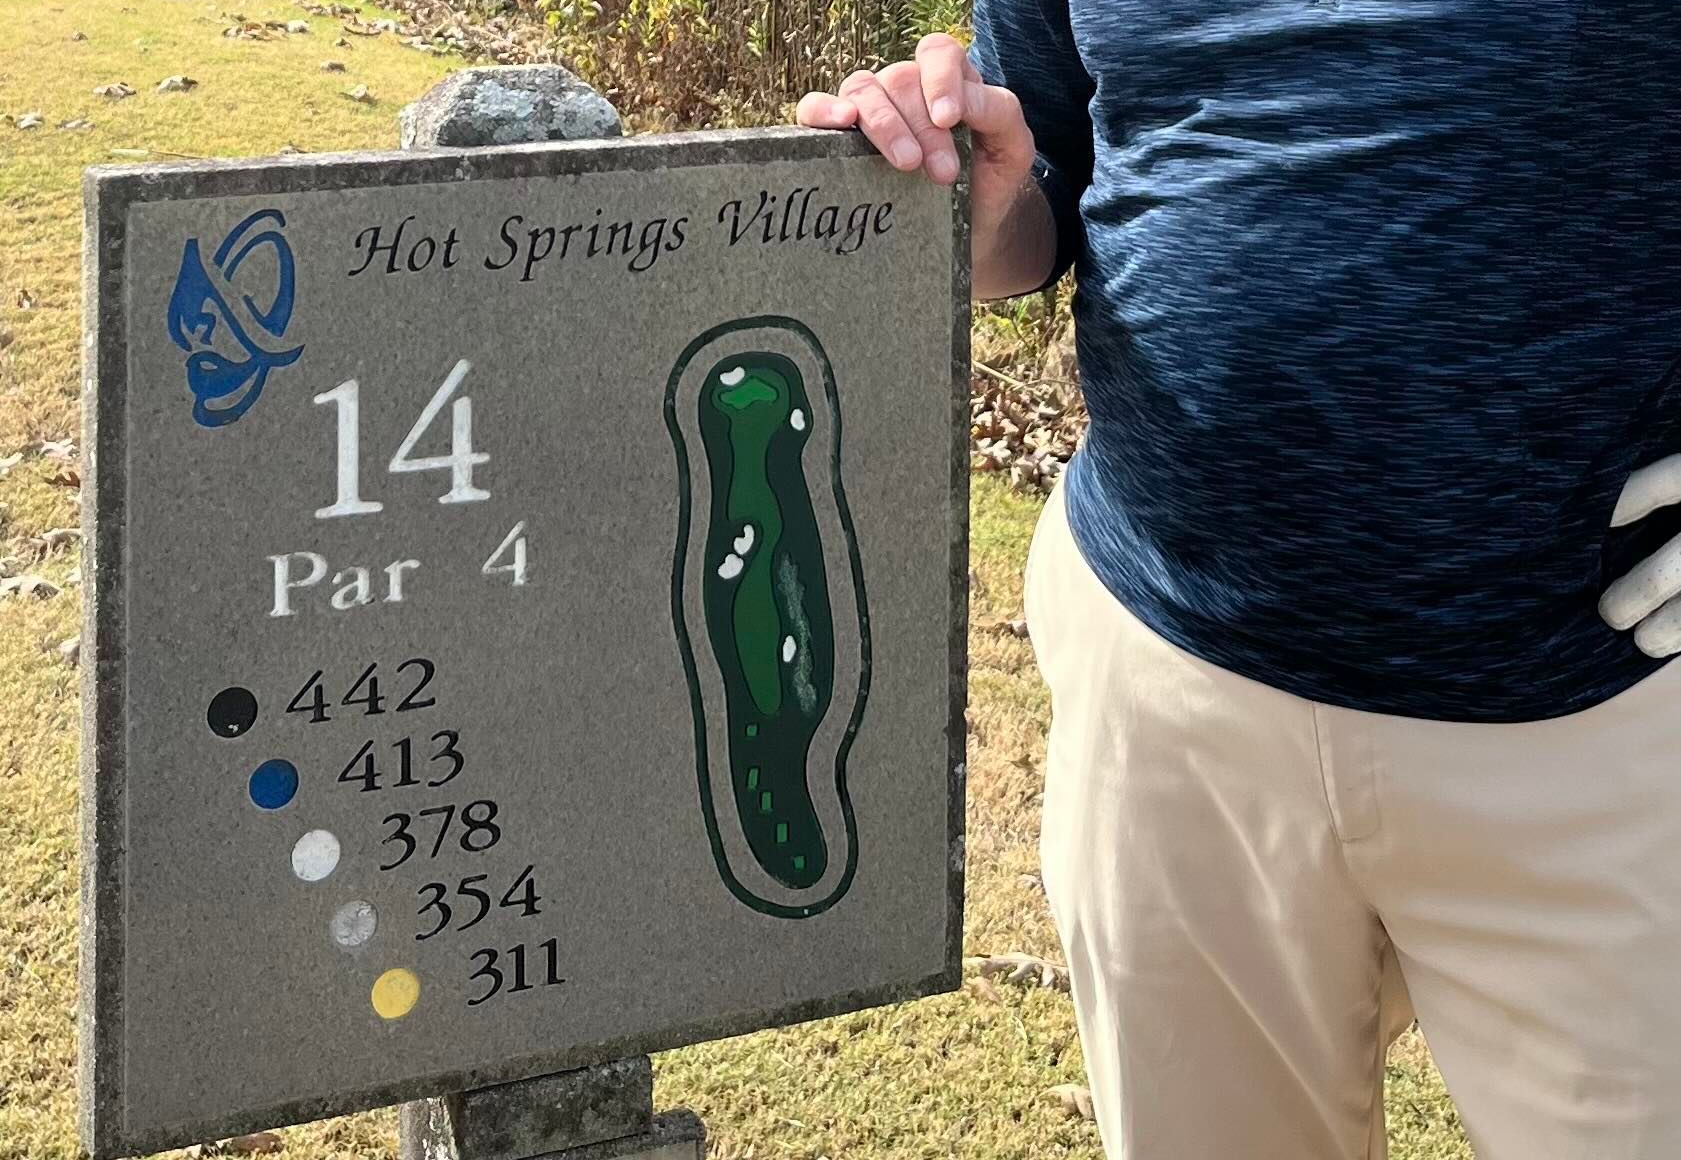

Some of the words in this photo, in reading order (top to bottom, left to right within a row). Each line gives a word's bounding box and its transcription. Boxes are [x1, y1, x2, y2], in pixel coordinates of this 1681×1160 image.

[349, 216, 459, 277] Hot
[484, 209, 689, 281] Springs
[718, 187, 895, 256] Village
[314, 359, 491, 520] 14
[267, 551, 419, 617] Par
[482, 521, 529, 587] 4
[286, 658, 437, 724] 442
[338, 729, 465, 793] 413
[380, 799, 501, 871] 378
[415, 864, 542, 941] 354
[468, 939, 566, 1005] 311
